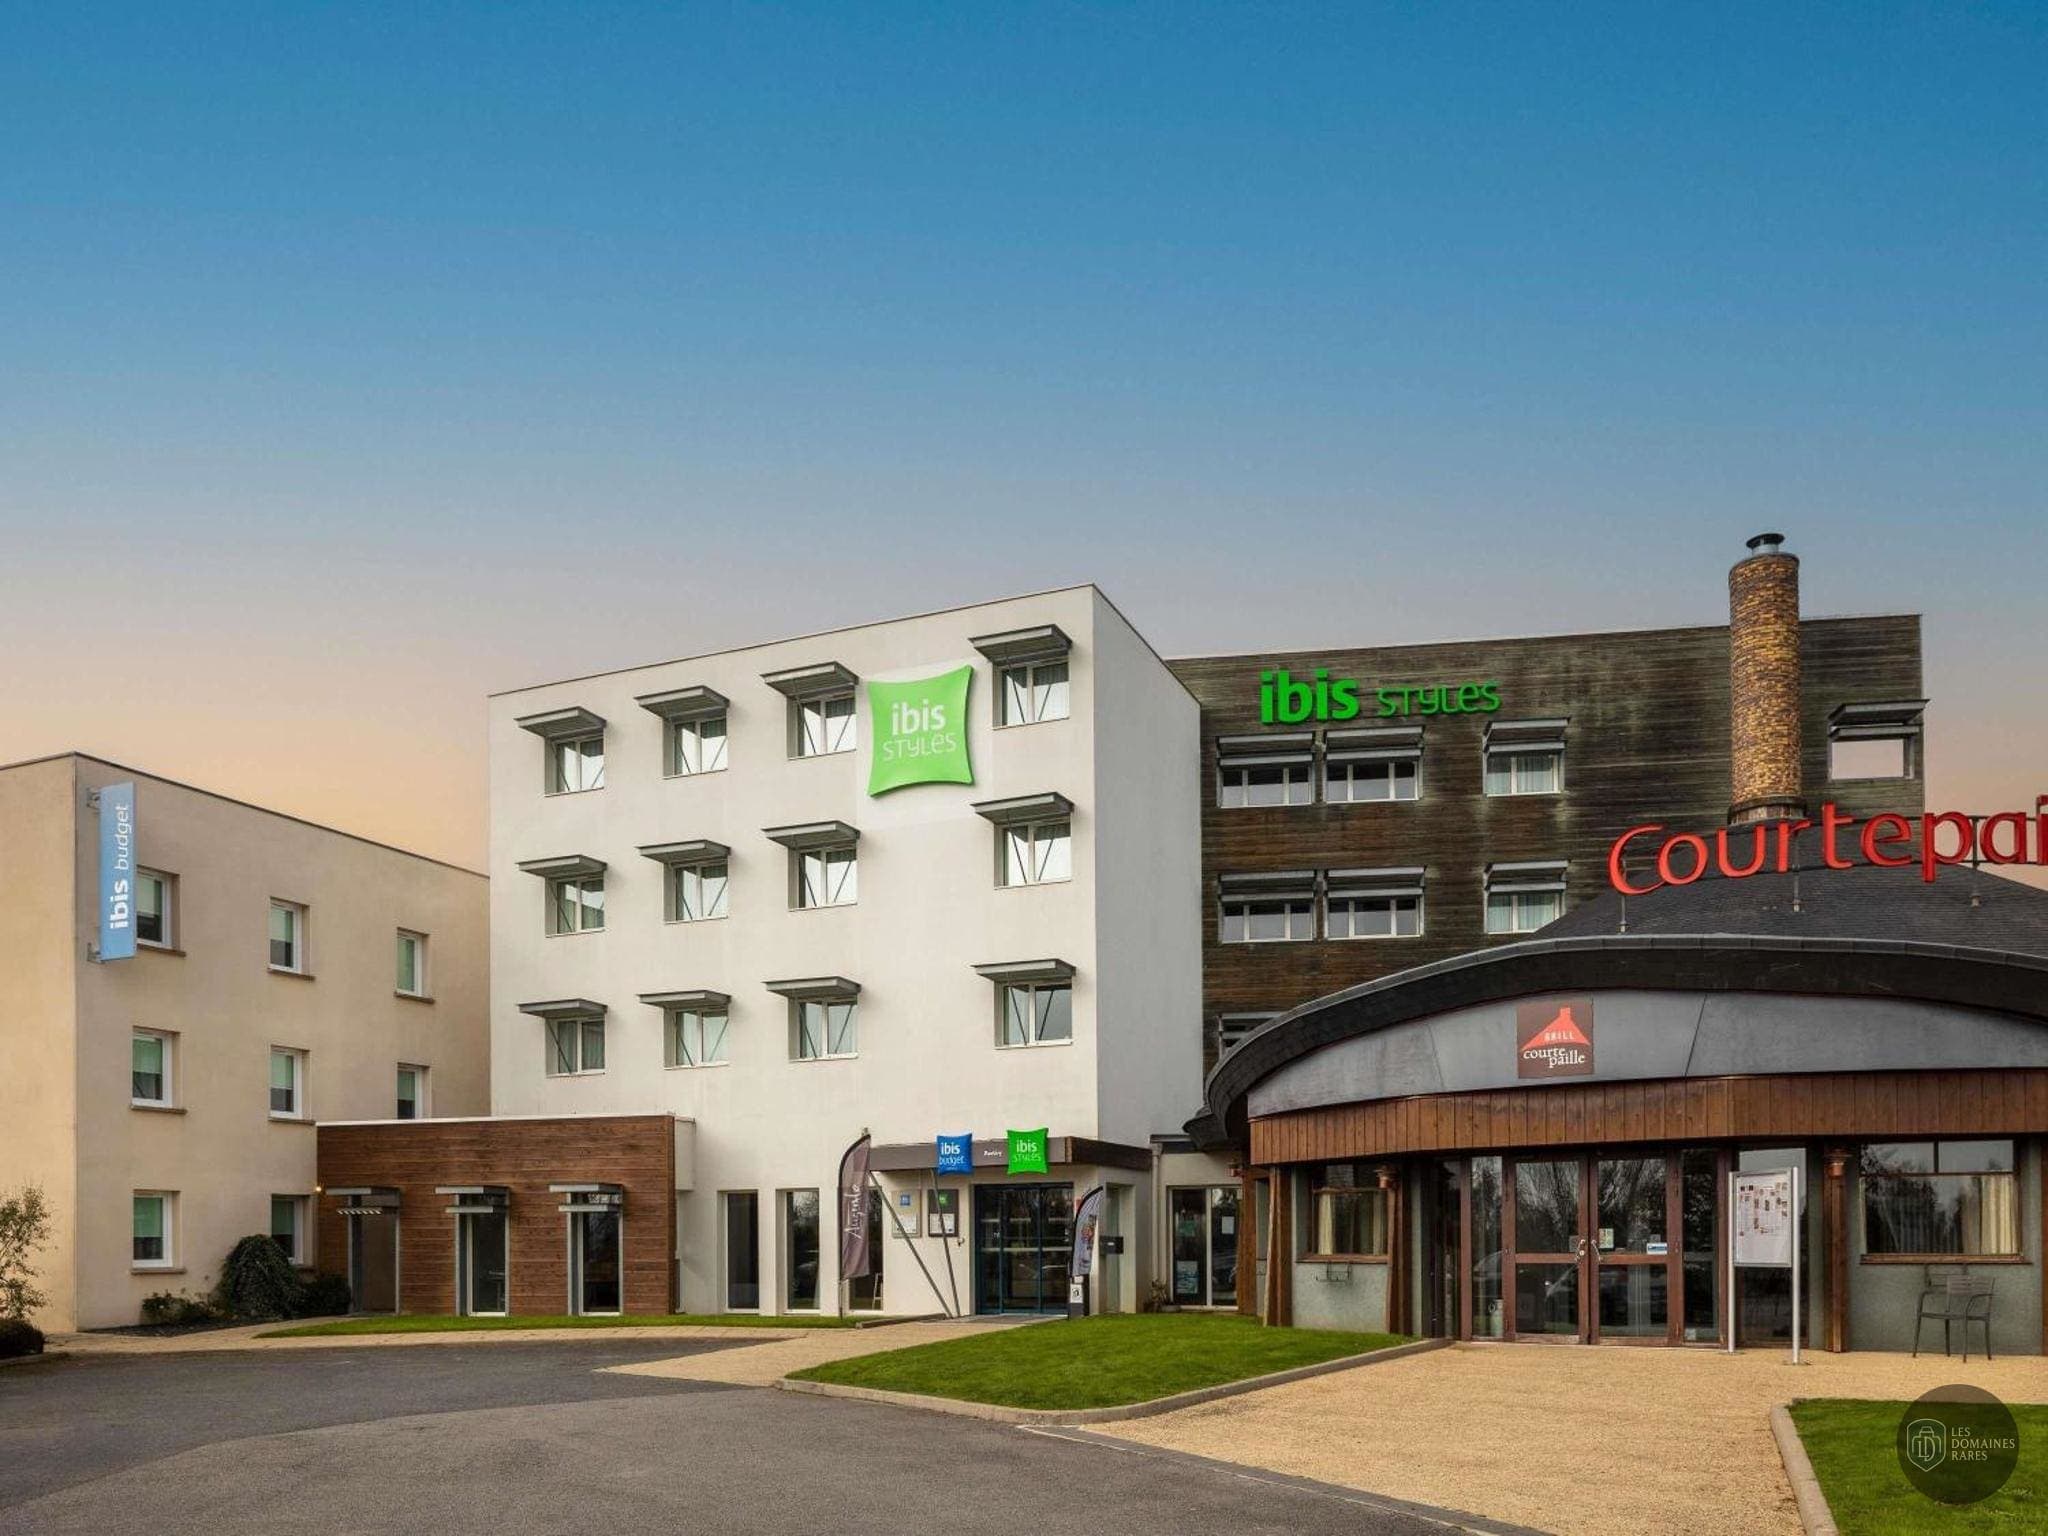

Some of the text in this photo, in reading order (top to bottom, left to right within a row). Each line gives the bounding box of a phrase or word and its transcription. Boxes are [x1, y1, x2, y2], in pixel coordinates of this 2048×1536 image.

[1260, 667, 1361, 725] ibis
[891, 698, 946, 736] ibis
[109, 804, 132, 929] ibis budget
[1523, 1047, 1566, 1059] courte
[1549, 1049, 1586, 1069] paille
[940, 1142, 960, 1155] ibis
[1016, 1140, 1037, 1153] ibis
[939, 1155, 965, 1167] budget
